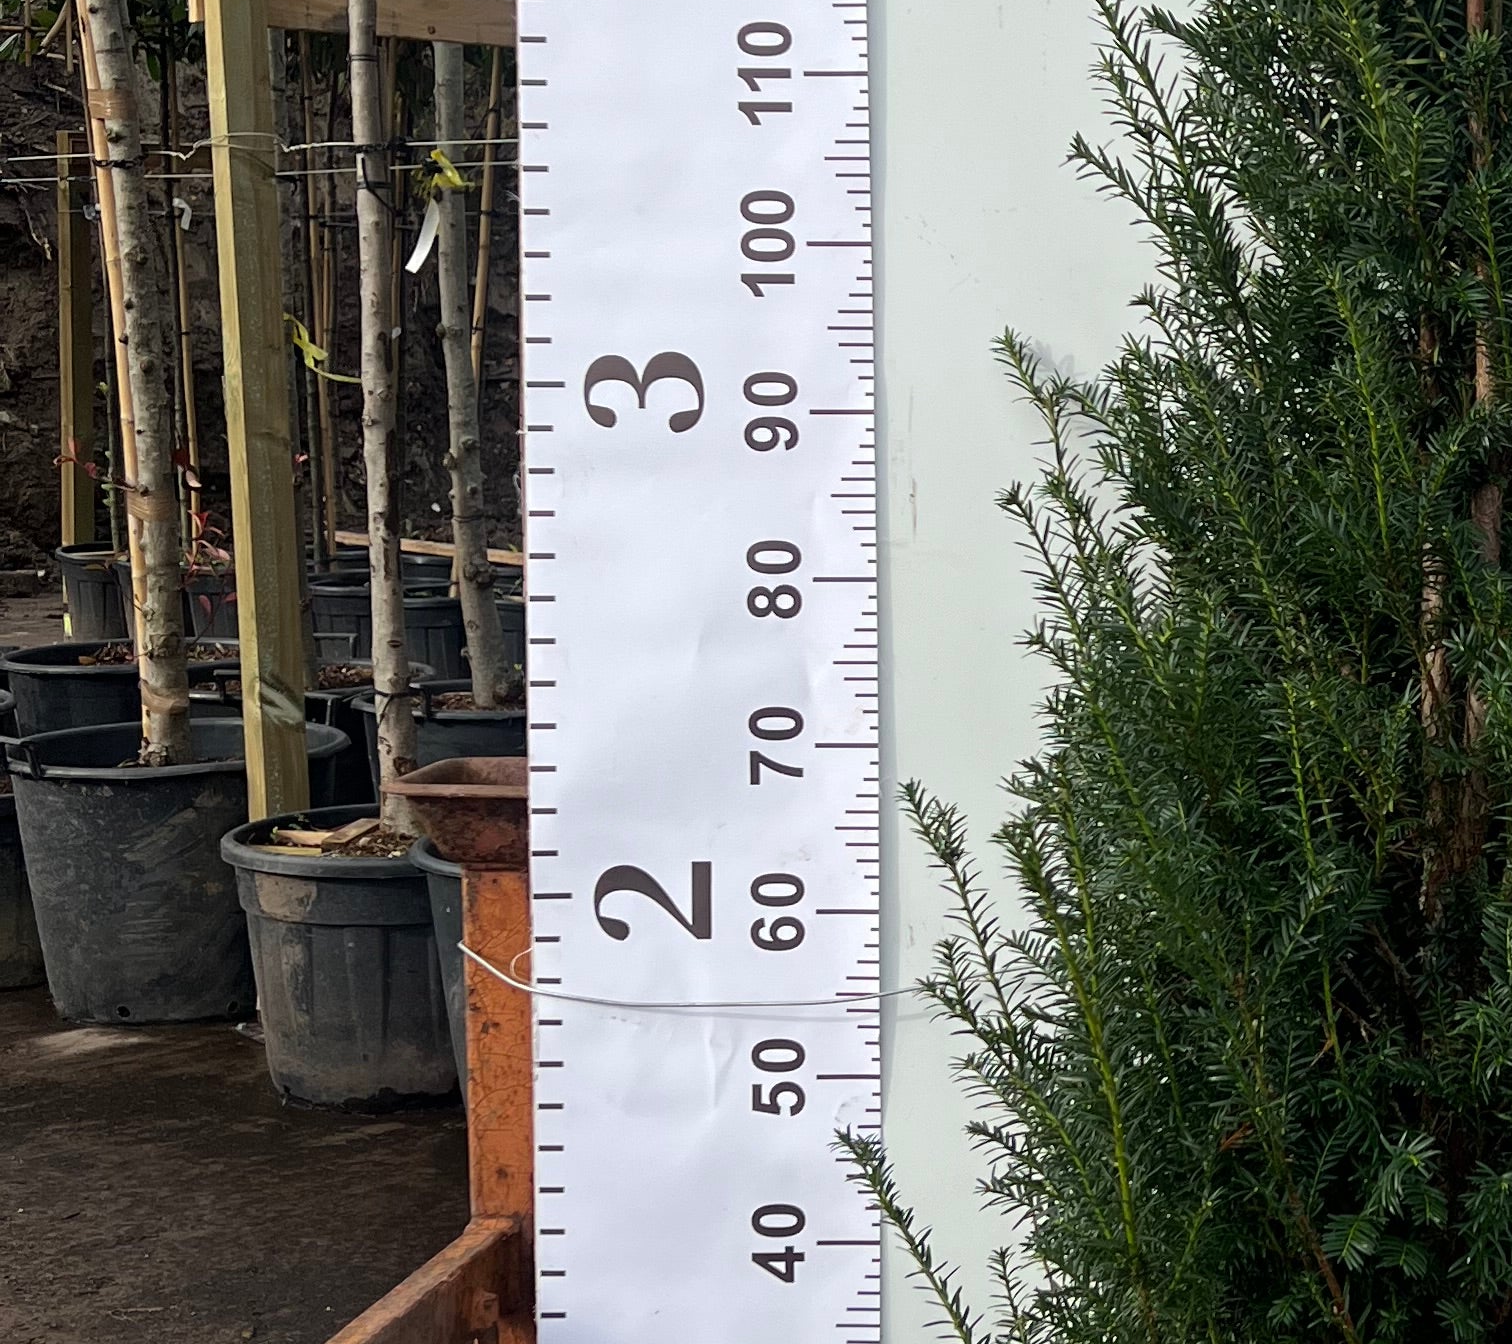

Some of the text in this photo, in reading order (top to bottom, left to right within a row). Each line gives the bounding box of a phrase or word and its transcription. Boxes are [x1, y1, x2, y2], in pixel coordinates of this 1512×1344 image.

[738, 23, 793, 126] 110
[741, 191, 796, 298] 100
[584, 352, 705, 434] 3
[743, 373, 799, 452] 90
[747, 541, 802, 620] 80
[749, 707, 804, 786] 70
[594, 862, 712, 941] 2
[751, 874, 805, 952] 60
[752, 1039, 806, 1117] 50
[752, 1204, 806, 1284] 40
